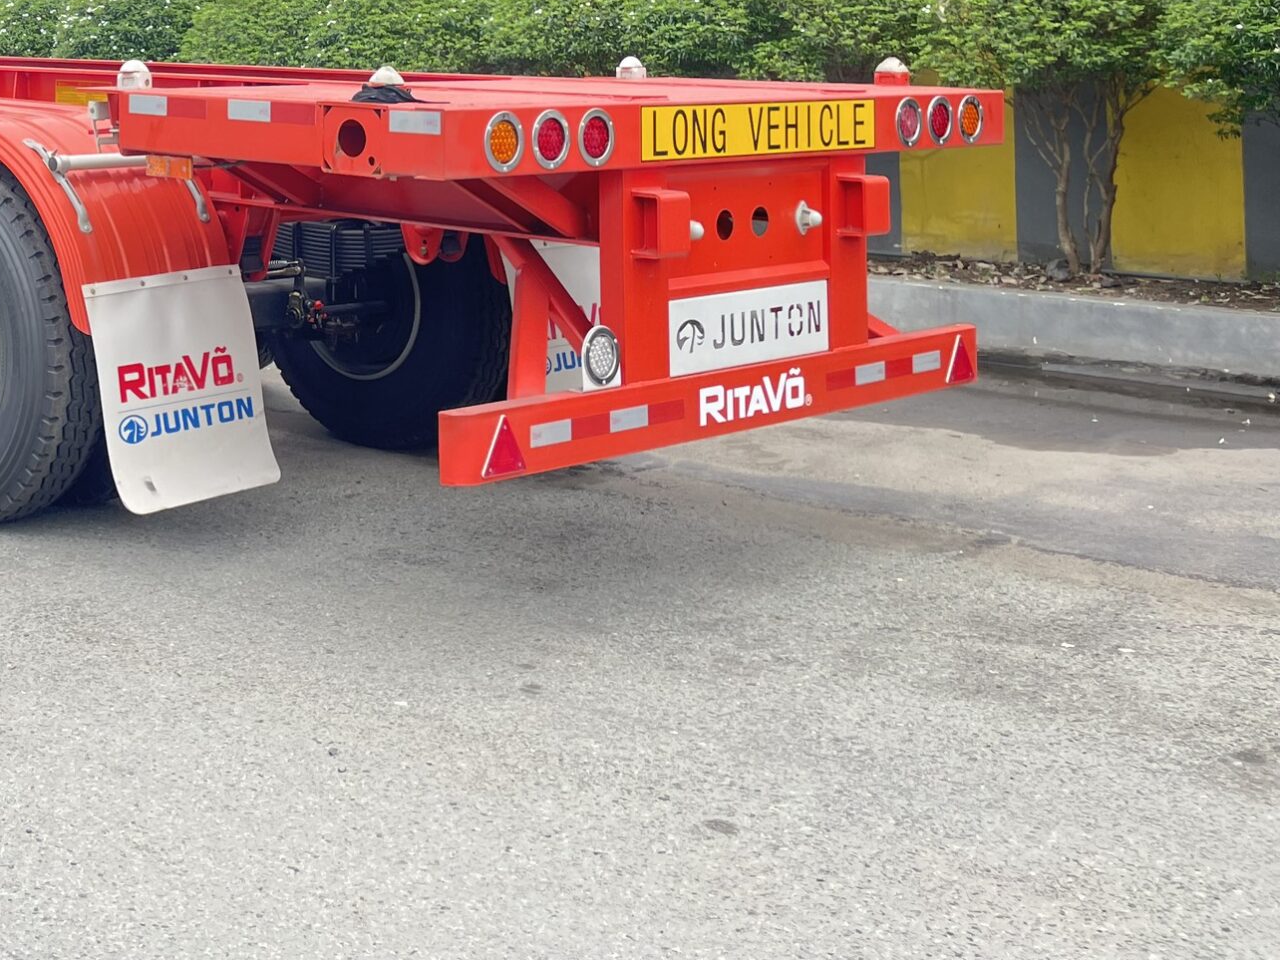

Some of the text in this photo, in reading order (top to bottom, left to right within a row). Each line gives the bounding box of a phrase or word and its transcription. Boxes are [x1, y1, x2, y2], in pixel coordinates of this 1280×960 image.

[652, 103, 866, 157] LONG VEHICLE
[713, 300, 821, 350] JUNTON
[151, 396, 254, 437] JUNTON
